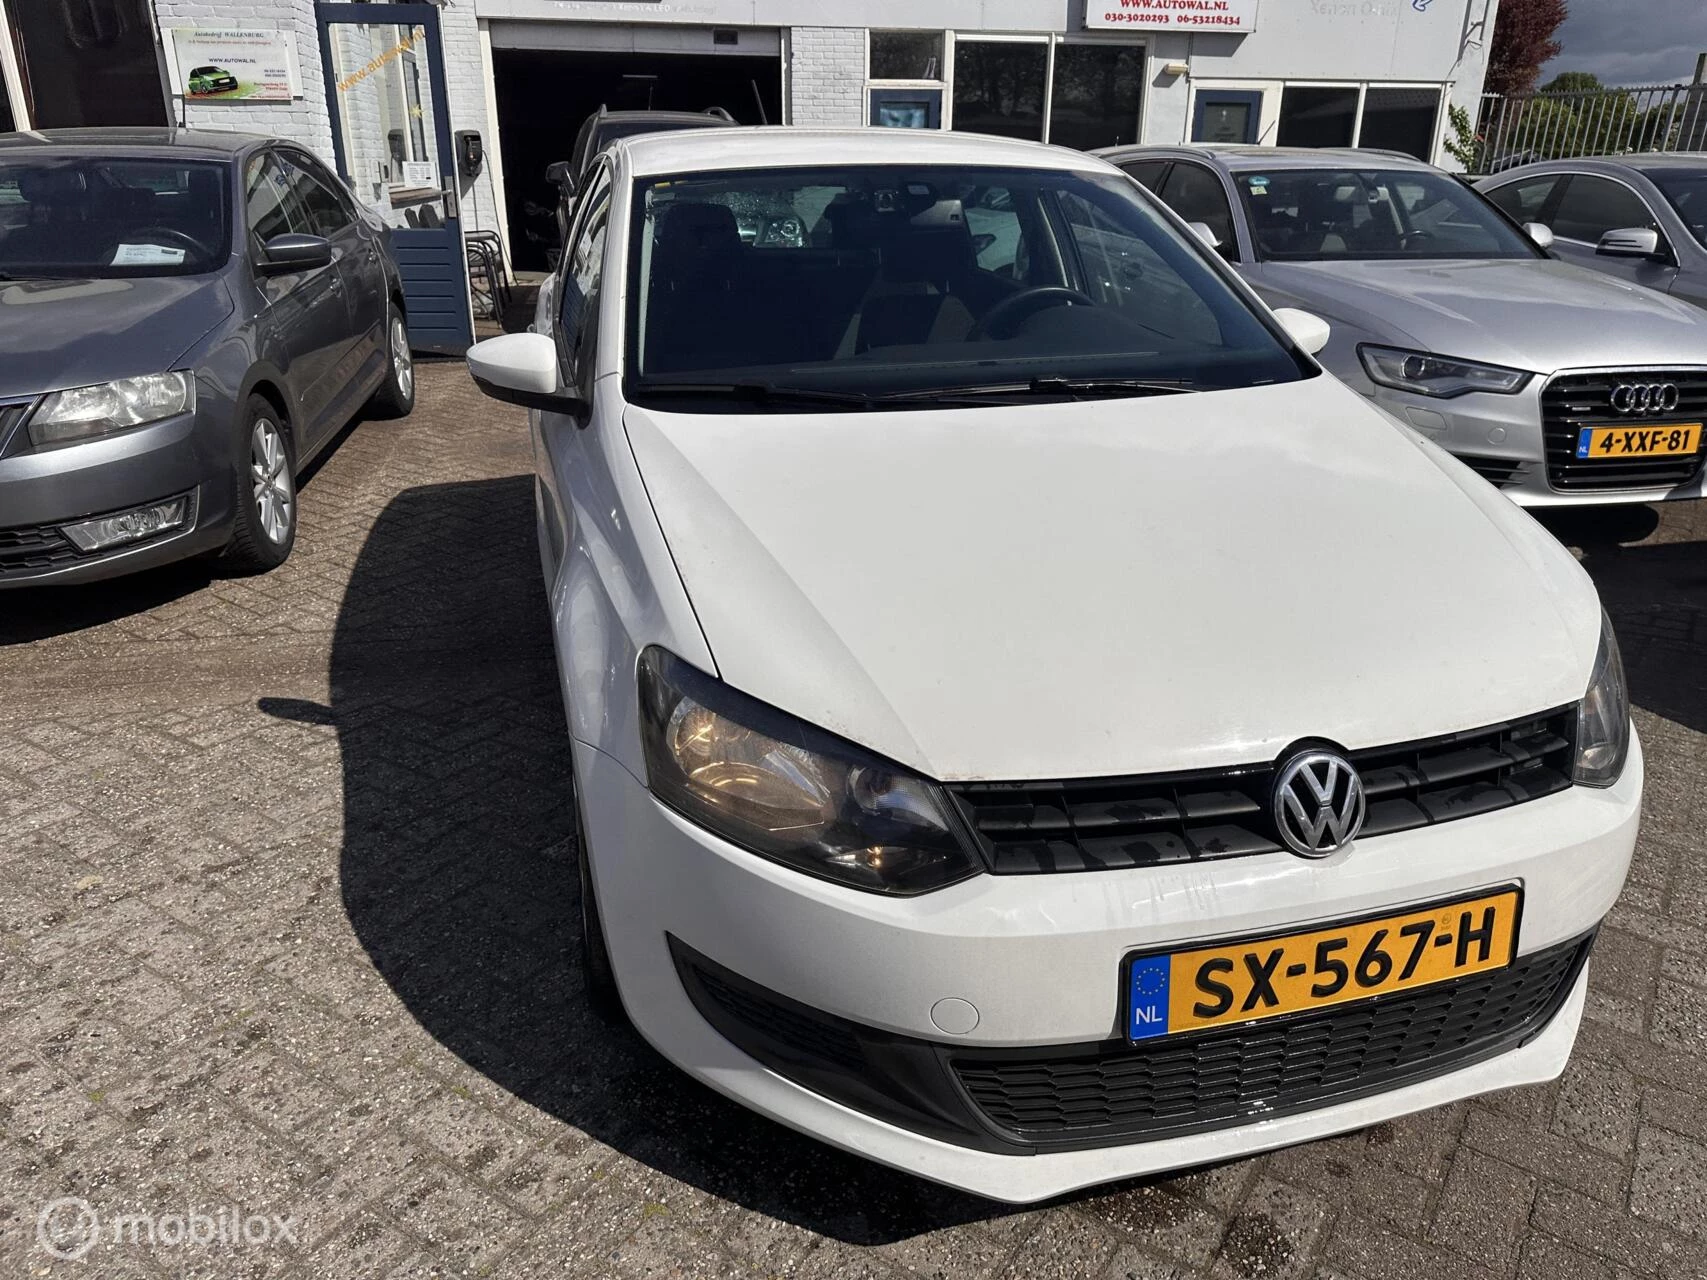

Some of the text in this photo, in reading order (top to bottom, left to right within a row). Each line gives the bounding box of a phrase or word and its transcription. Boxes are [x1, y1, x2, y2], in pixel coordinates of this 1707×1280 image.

[1120, 0, 1229, 10] WWW.AUTOWAL.NL
[1104, 13, 1240, 25] 030-3020293 06-53218434
[1600, 429, 1690, 454] 4-XXF-81
[1136, 907, 1496, 1025] NL SX-567-H
